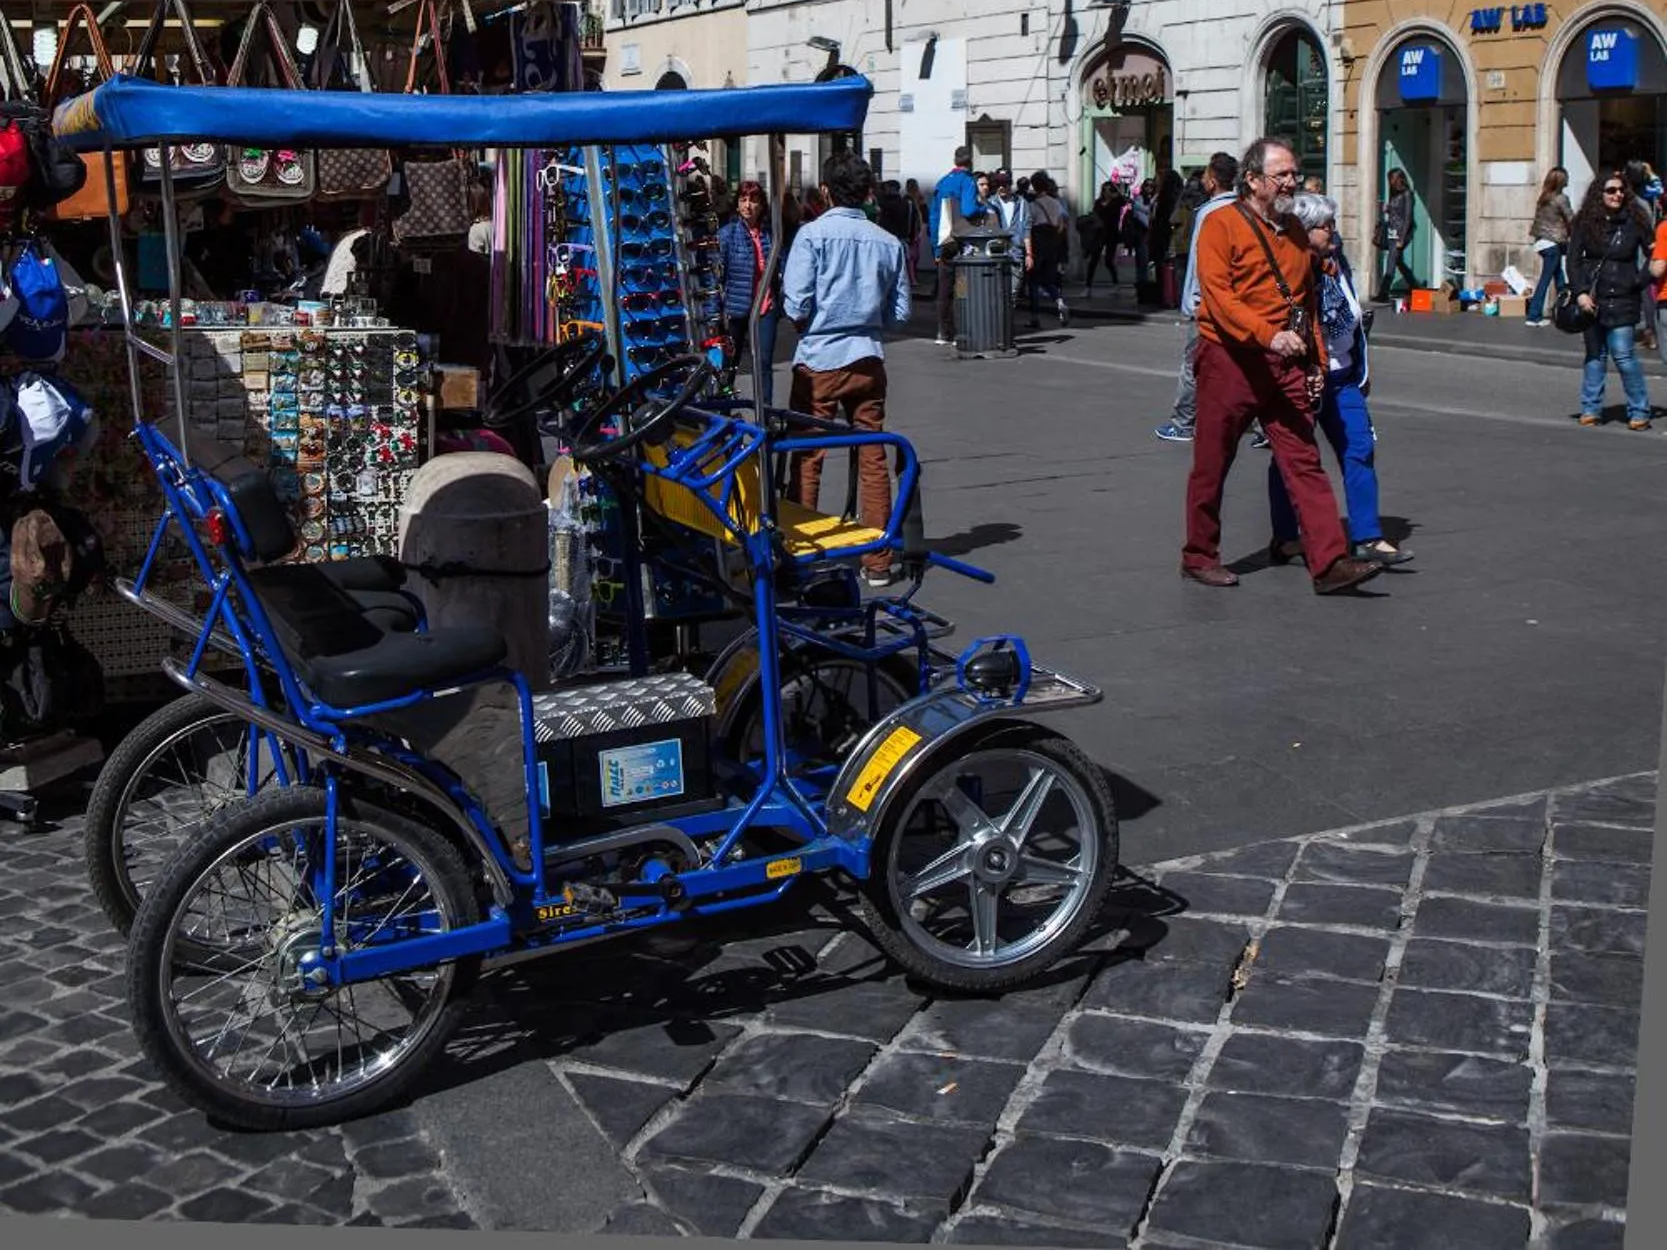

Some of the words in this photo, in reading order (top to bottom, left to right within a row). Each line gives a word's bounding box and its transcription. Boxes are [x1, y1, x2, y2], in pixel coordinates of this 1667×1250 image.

[1471, 7, 1504, 32] AW
[1511, 3, 1548, 30] LAB
[1591, 32, 1617, 49] AW
[1402, 49, 1424, 65] AW
[1590, 50, 1610, 62] LAB
[1401, 64, 1418, 76] LAB
